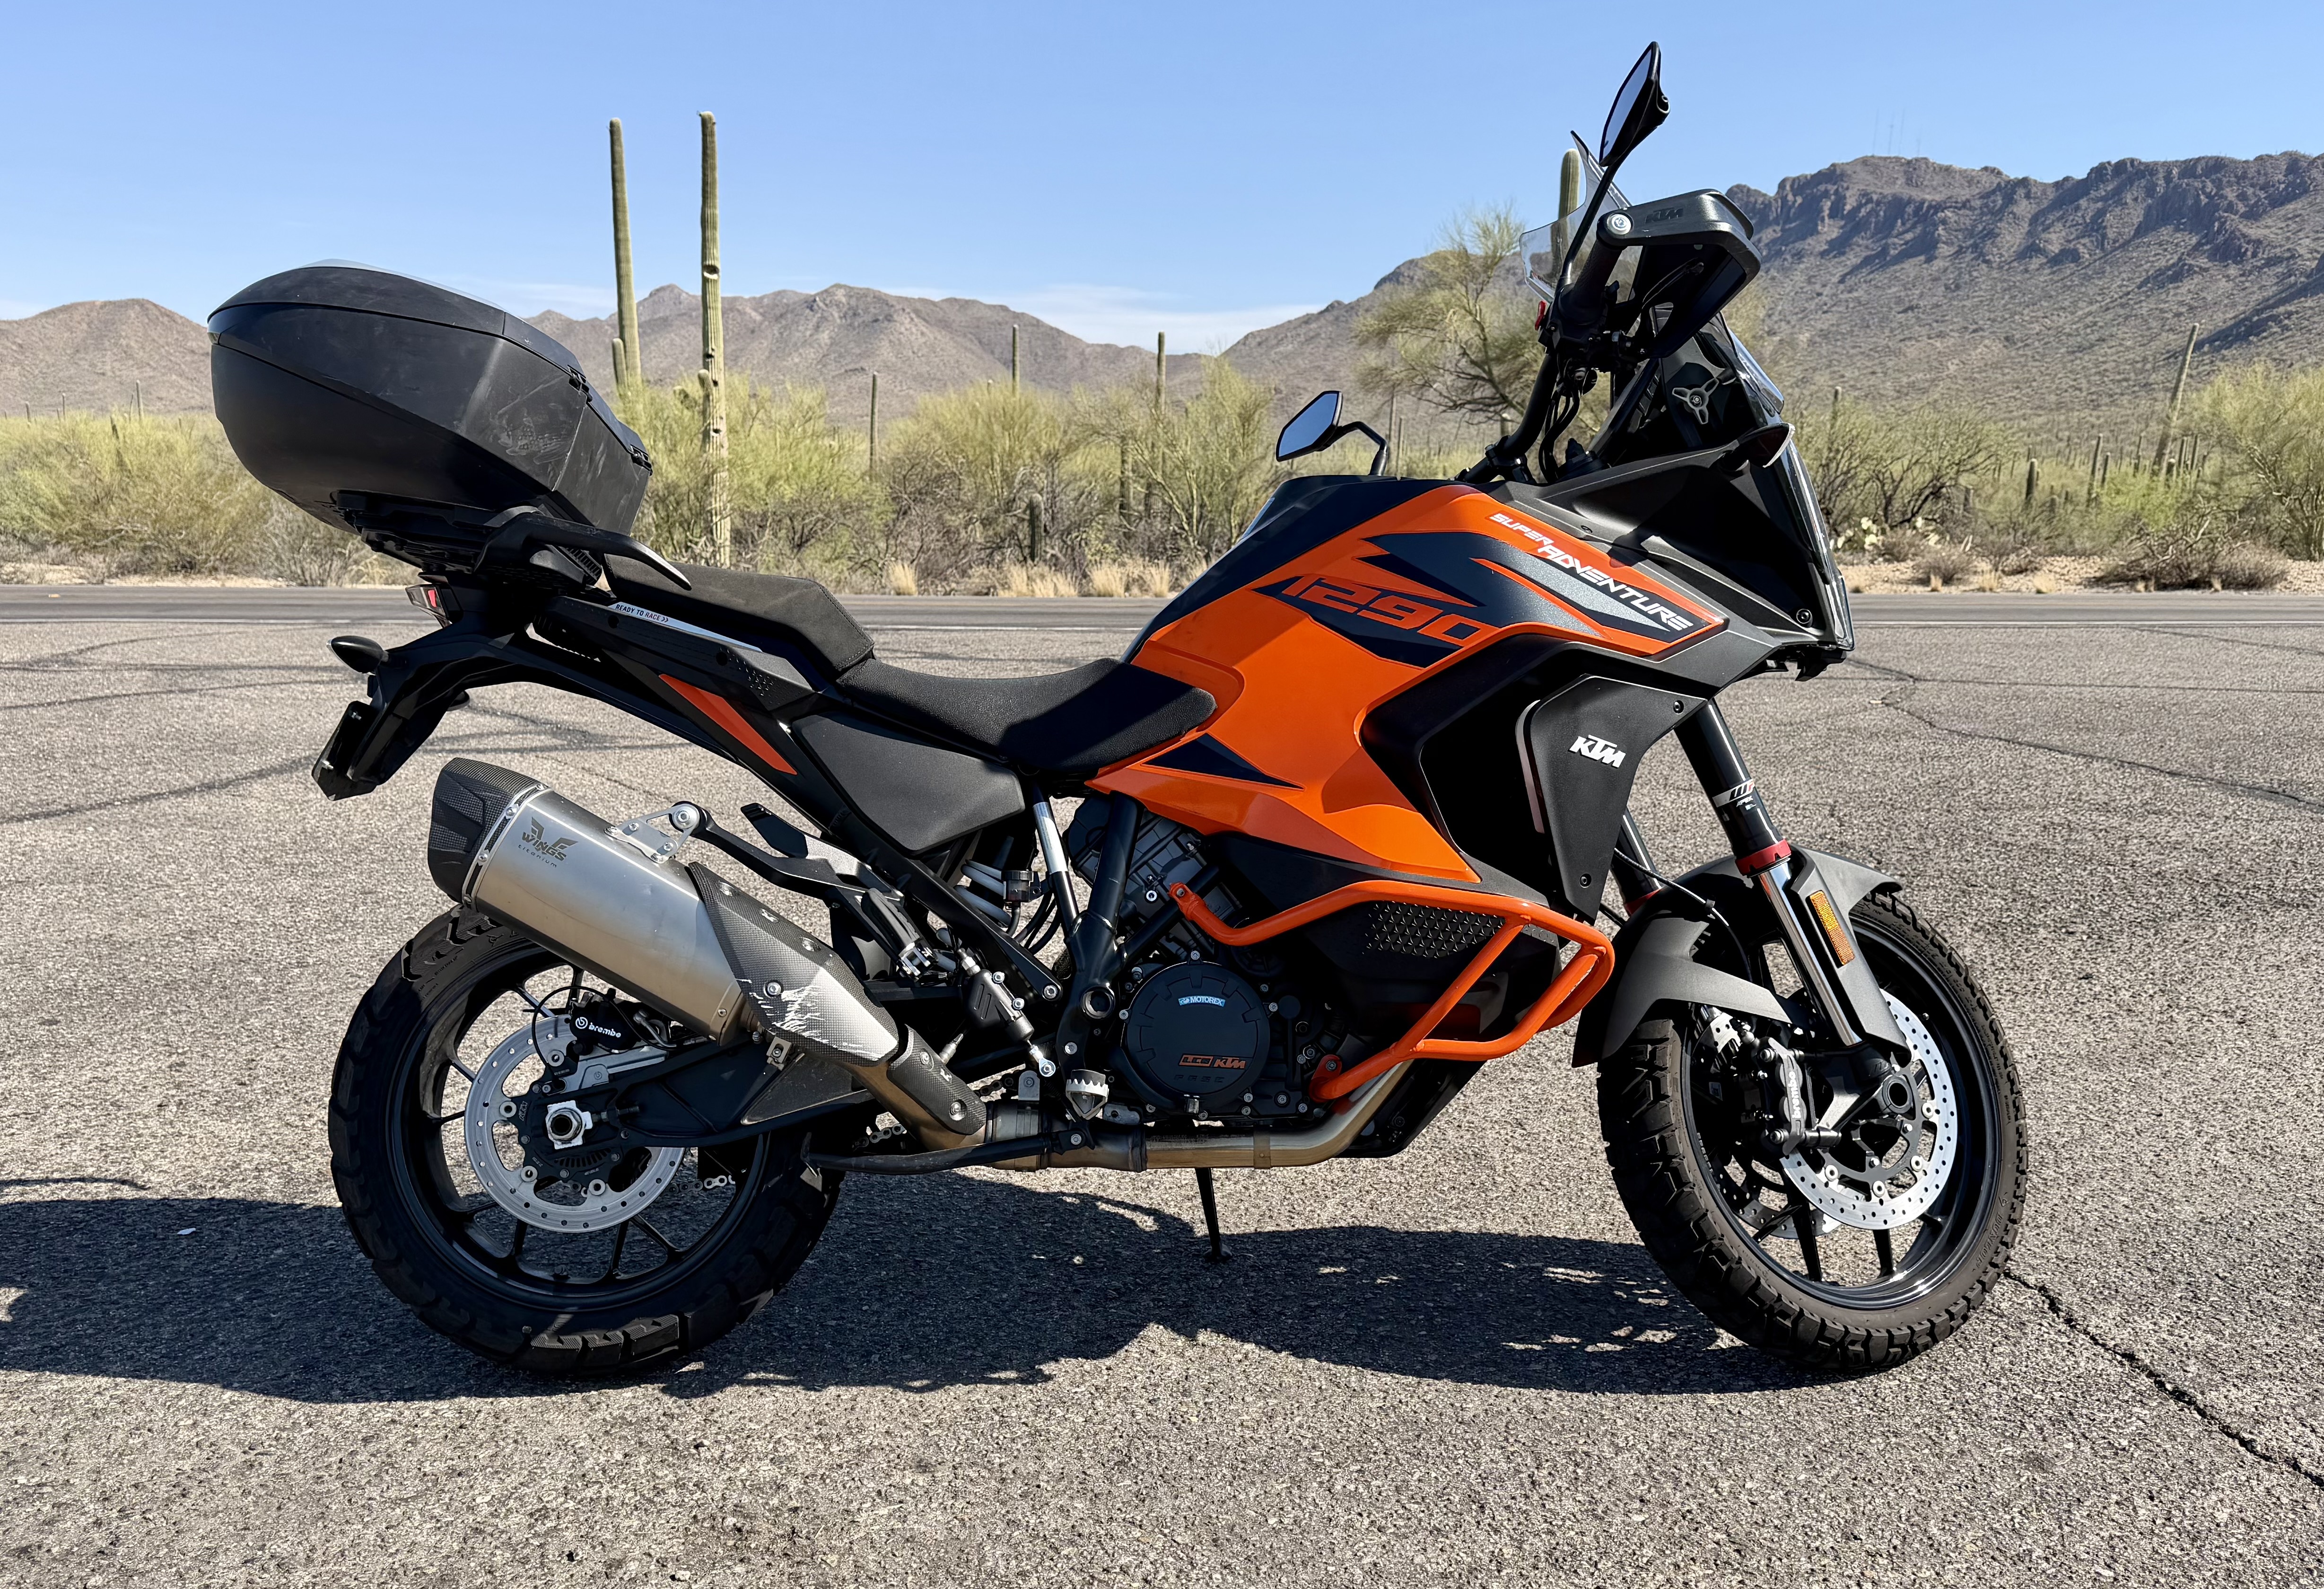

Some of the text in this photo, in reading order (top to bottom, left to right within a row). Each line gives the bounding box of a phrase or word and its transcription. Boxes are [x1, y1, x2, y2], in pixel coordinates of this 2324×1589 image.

[1644, 207, 1683, 224] KTM
[1489, 513, 1555, 545] SUPER
[1538, 544, 1694, 631] ADVENTURE
[615, 604, 635, 614] READY
[645, 612, 661, 621] RACE
[1282, 575, 1500, 649] 1290
[1569, 734, 1626, 768] KTM
[518, 844, 557, 868] titanium
[522, 832, 567, 861] WINGS
[1190, 996, 1224, 1007] MOTOREX
[589, 1022, 621, 1038] brembo
[1214, 1057, 1246, 1069] KTM
[1788, 1071, 1801, 1118] brembo
[1976, 1212, 2003, 1268] DUNLOP
